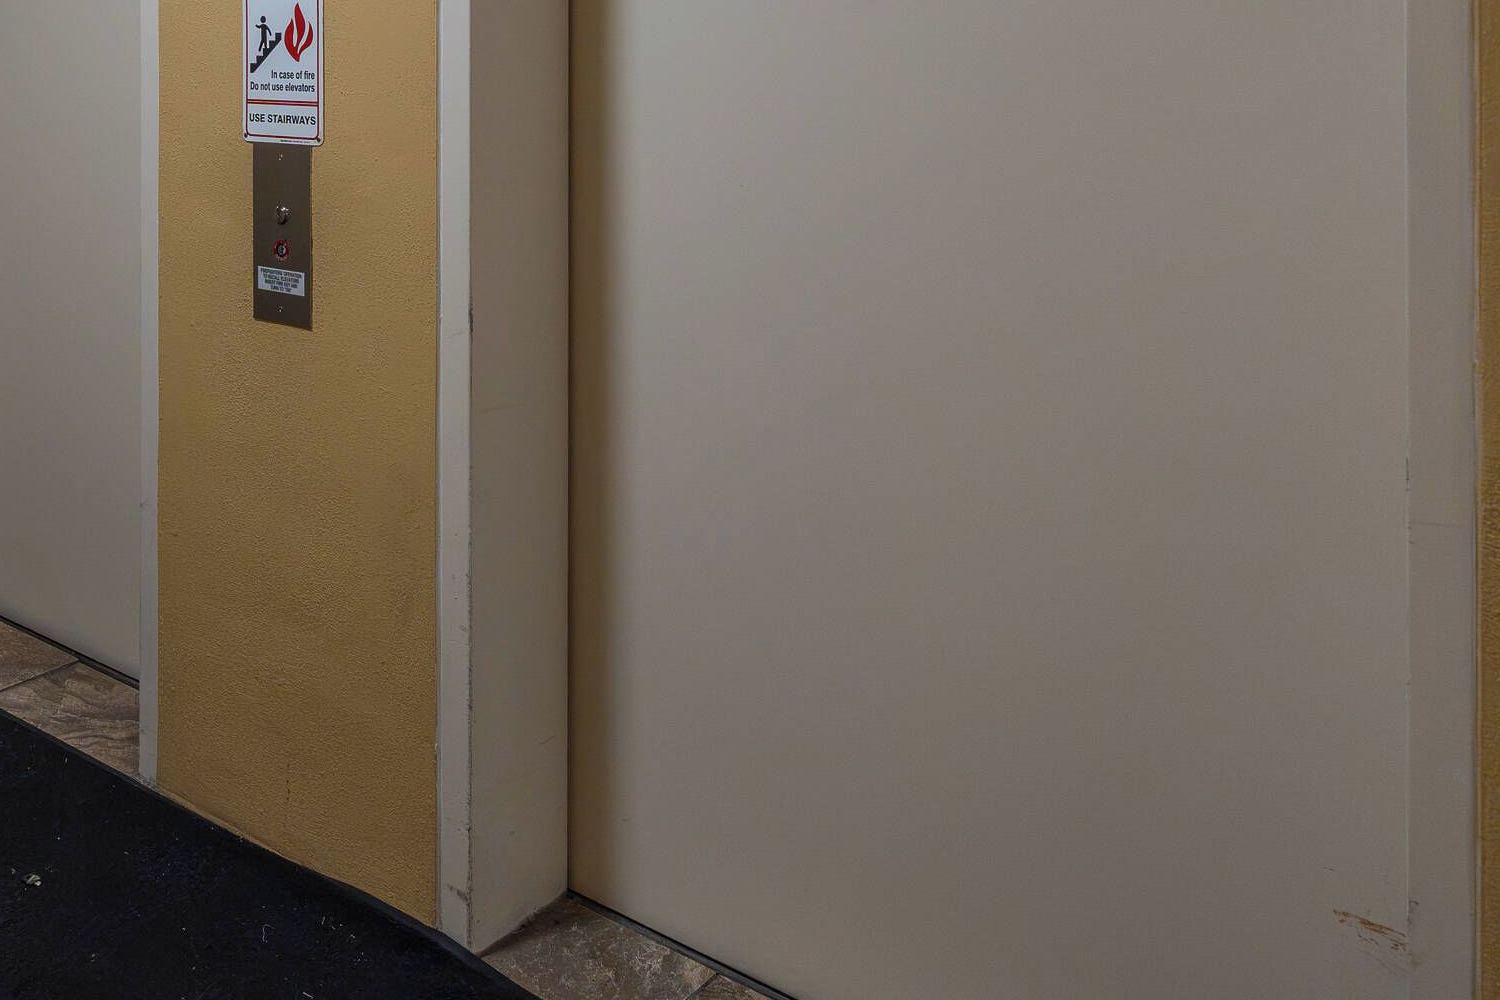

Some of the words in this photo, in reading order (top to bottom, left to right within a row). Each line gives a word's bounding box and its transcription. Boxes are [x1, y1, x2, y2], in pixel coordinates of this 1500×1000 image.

[271, 70, 277, 79] In
[279, 71, 294, 79] case
[296, 70, 302, 79] of
[304, 70, 315, 80] fire
[250, 81, 259, 90] Do
[260, 82, 270, 91] not
[272, 83, 283, 91] use
[285, 82, 315, 92] elevators
[249, 113, 265, 123] USE
[267, 114, 316, 126] STAIRWAYS
